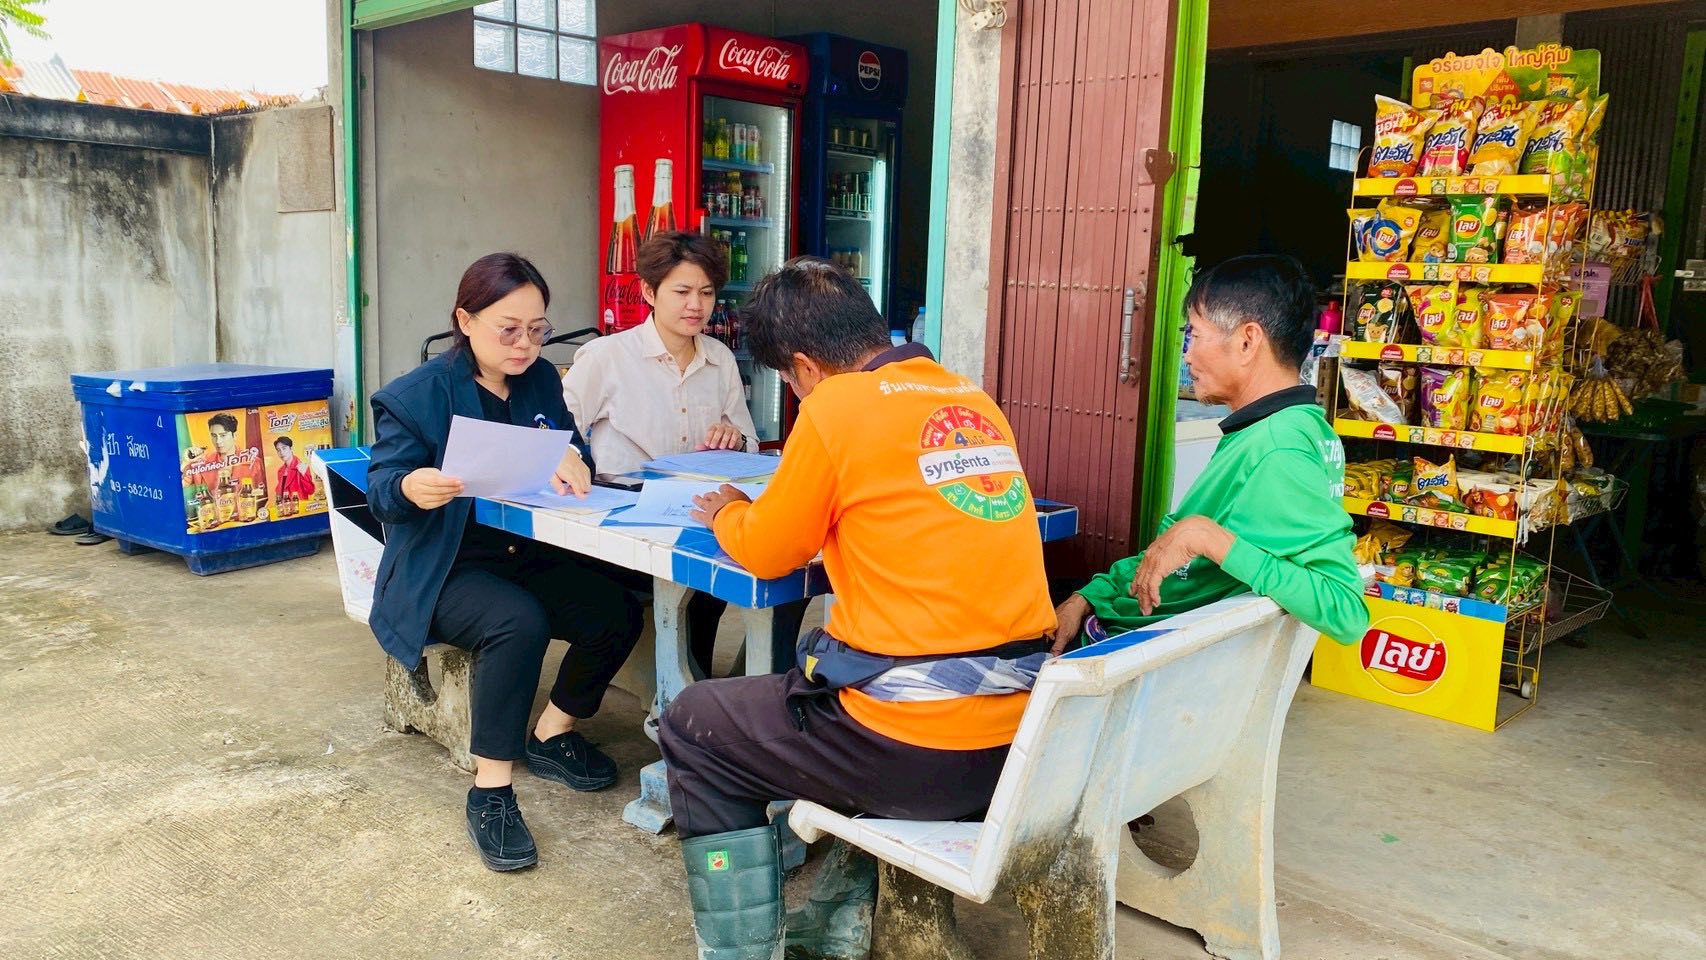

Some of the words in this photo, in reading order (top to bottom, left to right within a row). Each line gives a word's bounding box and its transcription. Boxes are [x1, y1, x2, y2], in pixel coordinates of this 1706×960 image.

[603, 44, 683, 95] Coca-Cola
[719, 38, 792, 81] Coca-Cola
[860, 65, 881, 76] PEPSI
[1425, 126, 1467, 150] ตะวัน
[1472, 125, 1519, 154] ตะวัน
[1374, 142, 1413, 165] ตะวัน
[925, 454, 990, 479] syngenta
[980, 475, 994, 492] 5
[1370, 632, 1438, 674] เลย์
